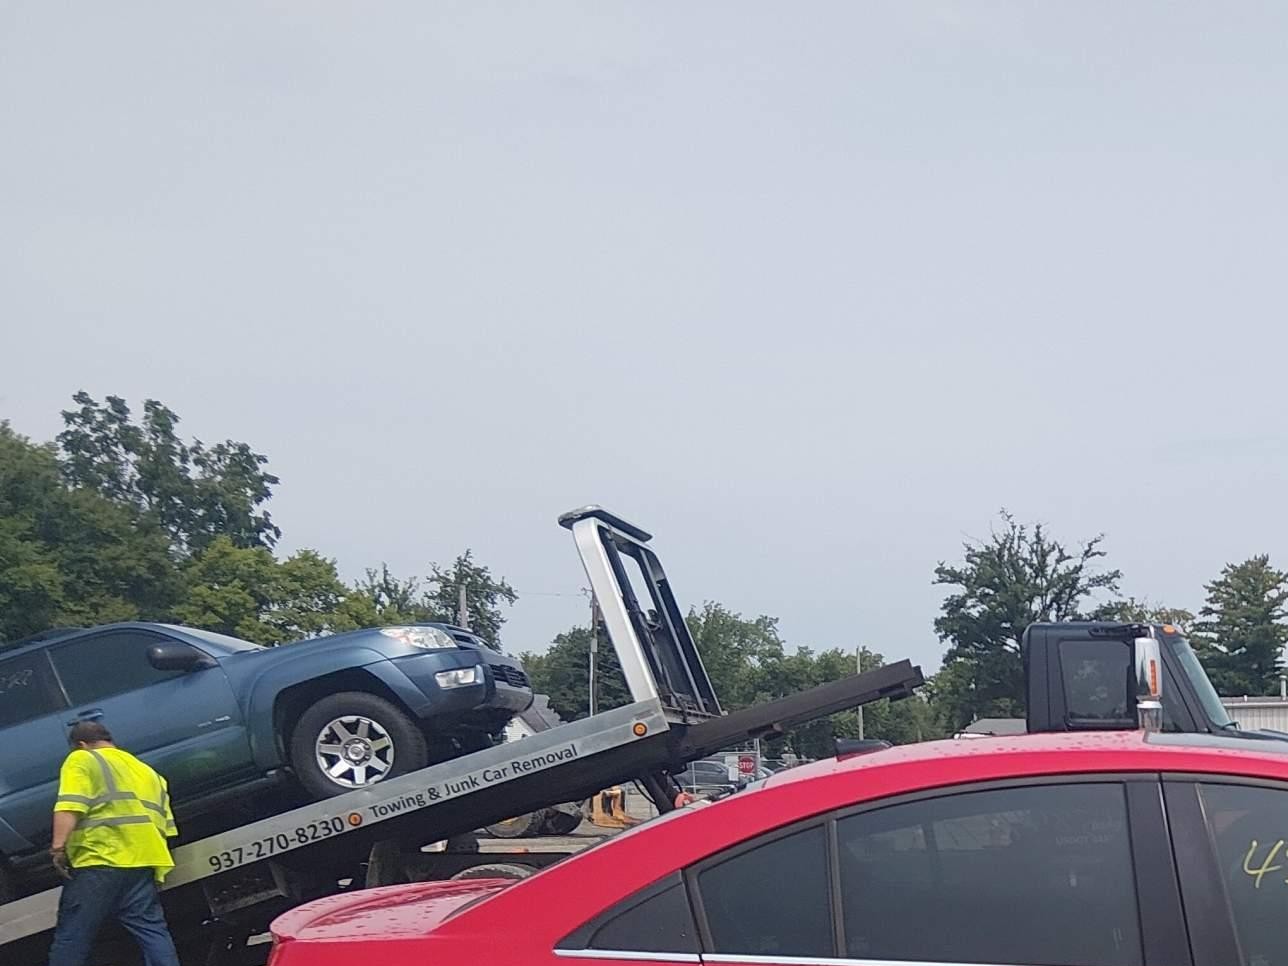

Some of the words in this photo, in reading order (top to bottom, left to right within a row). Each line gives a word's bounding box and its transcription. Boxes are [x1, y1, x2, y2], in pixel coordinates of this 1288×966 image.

[208, 816, 345, 872] 937-270-8230
[369, 793, 426, 818] Towing
[427, 787, 442, 801] &
[445, 776, 480, 796] Junk
[483, 769, 507, 783] Car
[511, 743, 578, 774] Removal
